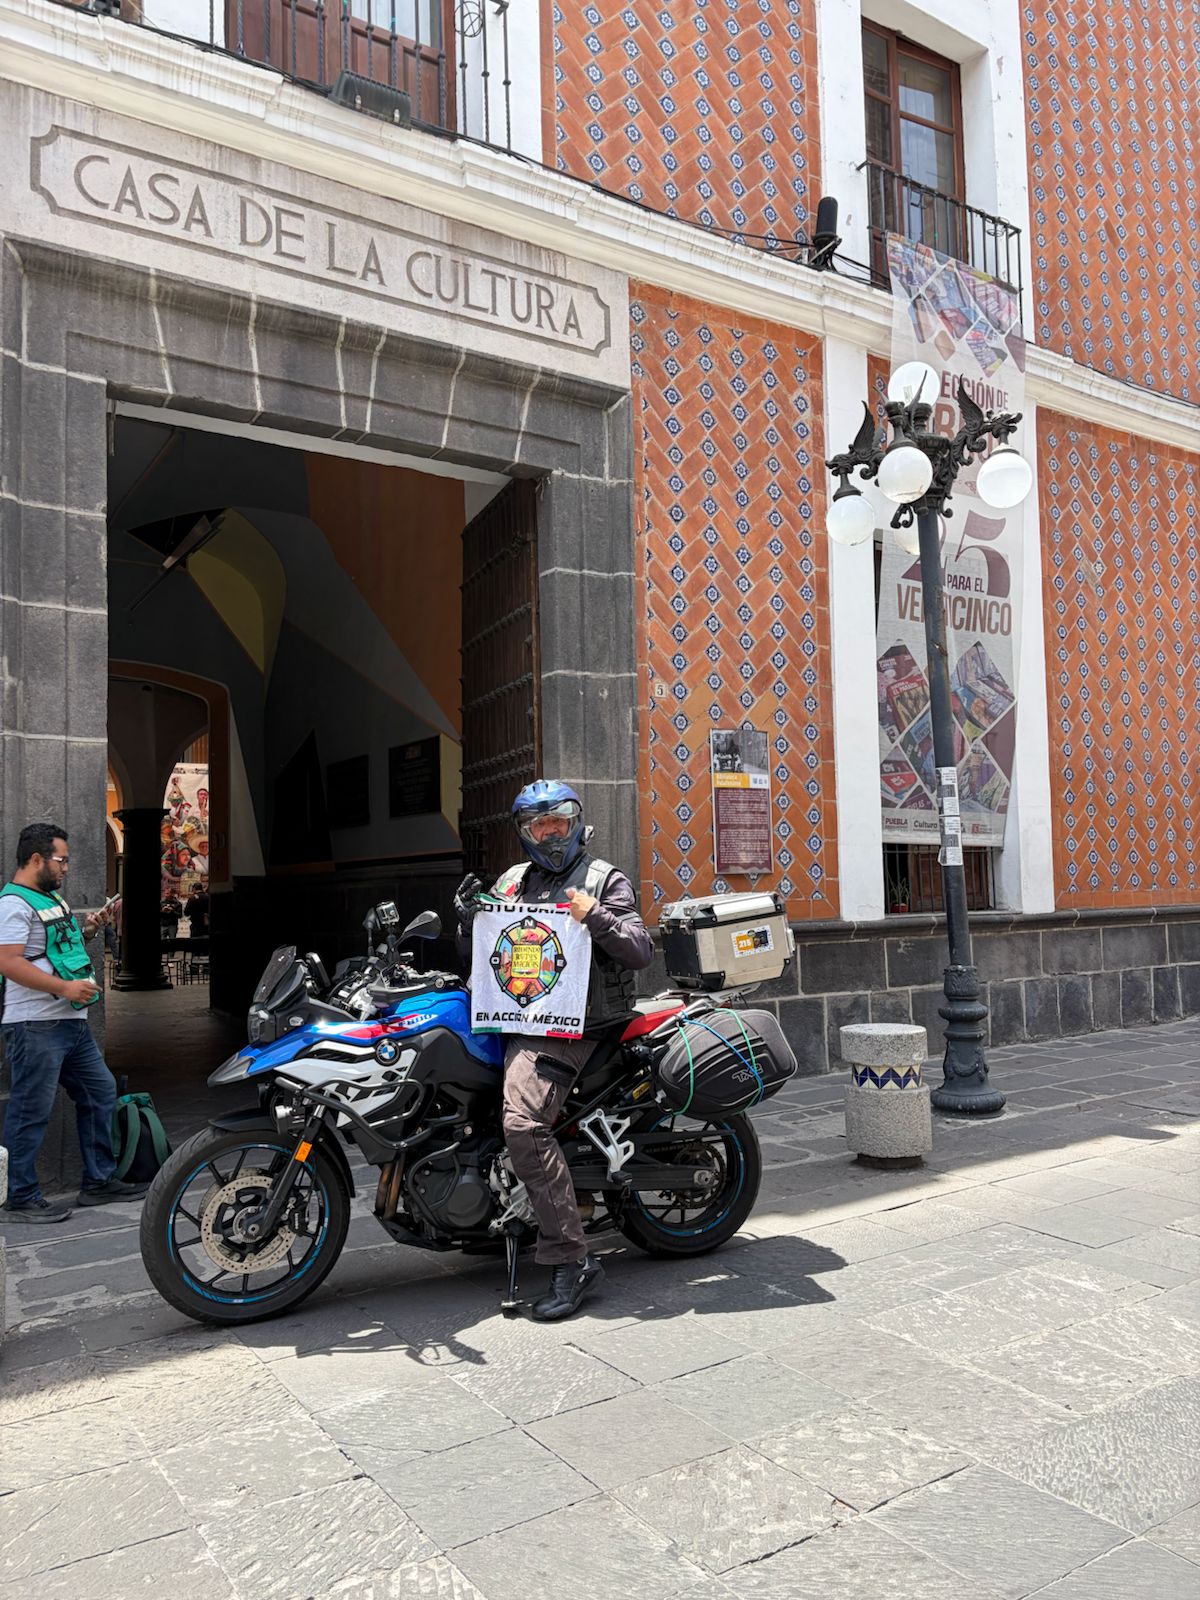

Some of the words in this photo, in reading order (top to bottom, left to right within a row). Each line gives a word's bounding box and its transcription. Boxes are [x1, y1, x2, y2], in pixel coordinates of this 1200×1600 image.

[74, 155, 214, 239] CASA
[238, 197, 306, 263] DE
[326, 221, 388, 288] LA
[405, 251, 585, 340] CULTURA
[997, 388, 1009, 410] DE
[947, 573, 971, 591] PARA
[974, 577, 985, 594] EL
[896, 583, 1012, 637] VETICINCO
[656, 684, 663, 696] 5
[885, 817, 908, 825] PUEBLA
[475, 1012, 490, 1022] EN
[532, 1011, 581, 1027] MÉXICO
